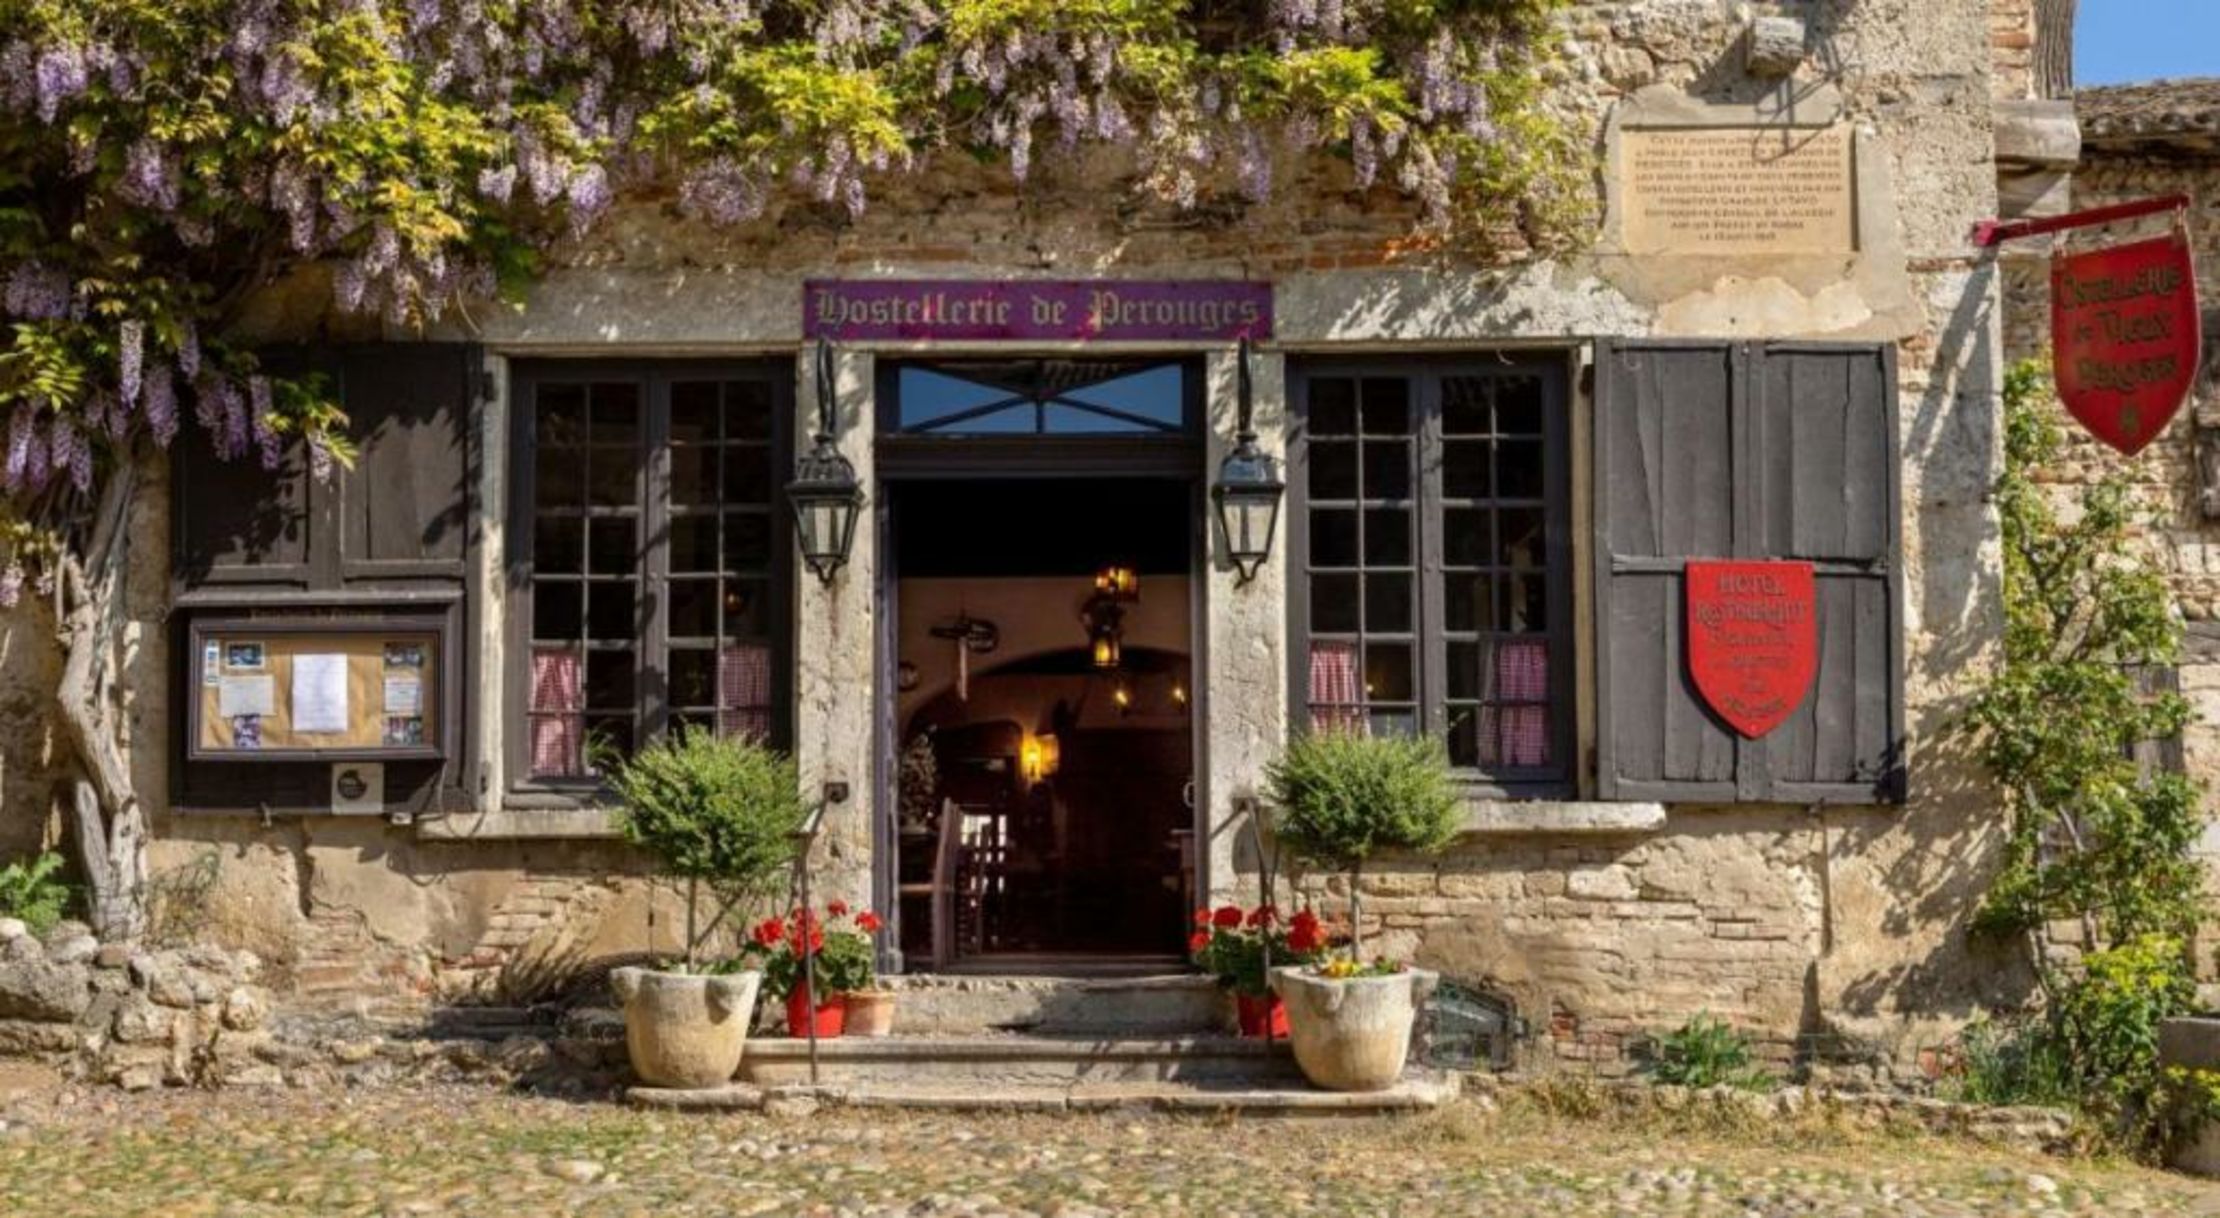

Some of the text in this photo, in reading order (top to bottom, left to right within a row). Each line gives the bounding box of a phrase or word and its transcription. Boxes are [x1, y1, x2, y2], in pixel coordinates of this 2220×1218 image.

[813, 288, 1260, 333] Hostellerie de Perouges
